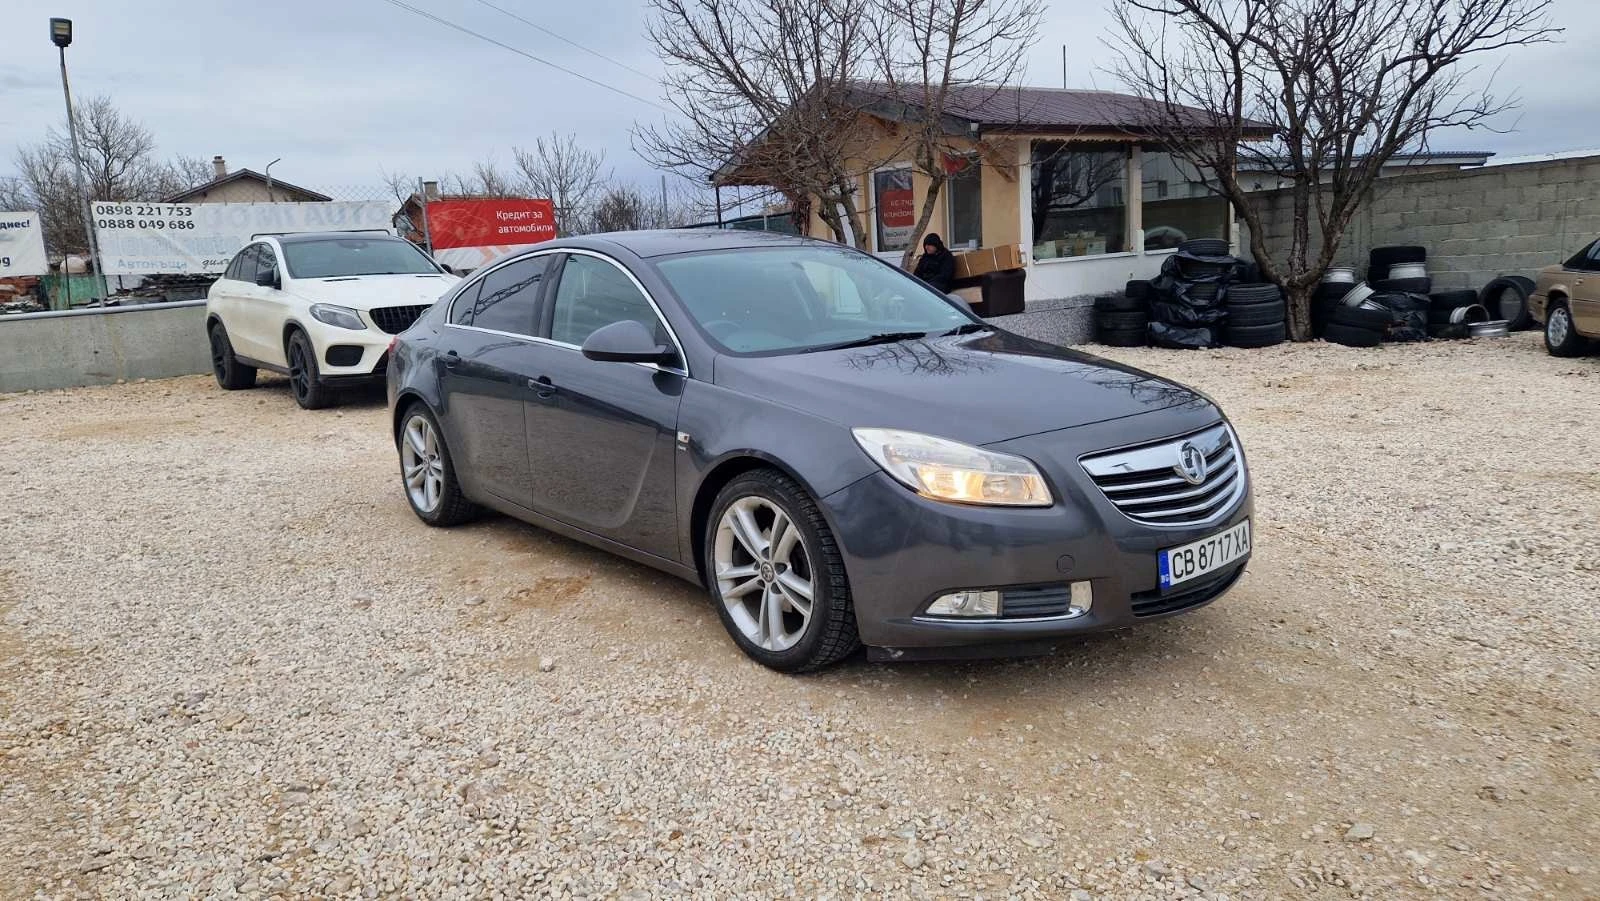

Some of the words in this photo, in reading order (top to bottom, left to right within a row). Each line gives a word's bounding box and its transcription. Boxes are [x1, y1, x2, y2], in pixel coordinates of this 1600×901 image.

[96, 205, 133, 215] 0898
[137, 206, 162, 216] 221
[166, 207, 192, 217] 753
[496, 210, 531, 221] Кредит
[532, 211, 543, 219] за
[98, 219, 135, 229] 0888
[138, 220, 165, 230] 049
[169, 220, 195, 230] 686
[498, 223, 553, 234] автомобили
[1198, 533, 1231, 570] 8717
